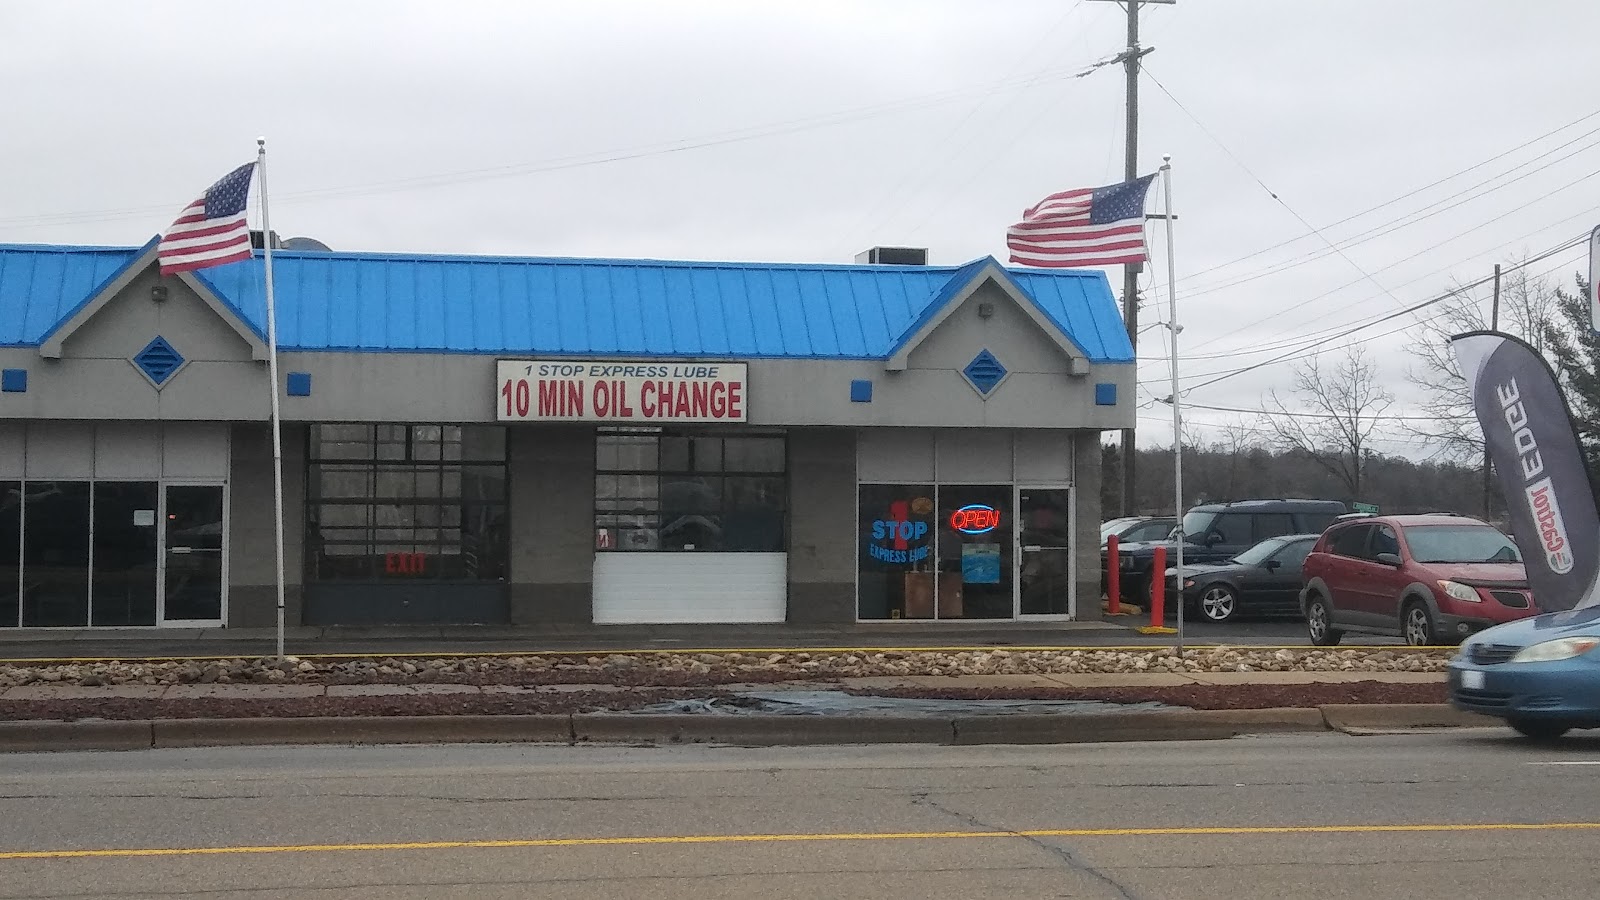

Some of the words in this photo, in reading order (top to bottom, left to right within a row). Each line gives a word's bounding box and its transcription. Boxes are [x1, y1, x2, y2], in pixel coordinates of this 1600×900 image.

[524, 365, 532, 376] 1
[538, 365, 585, 377] STOP
[589, 366, 669, 378] EXPRESS
[673, 366, 720, 379] LUBE
[501, 379, 530, 417] 10
[538, 379, 584, 418] MIN
[593, 380, 633, 418] OIL
[640, 381, 742, 418] CHANGE
[951, 509, 1001, 529] OPEN
[871, 519, 928, 541] STOP
[385, 552, 426, 574] EXIT
[870, 543, 907, 563] EXPRESS
